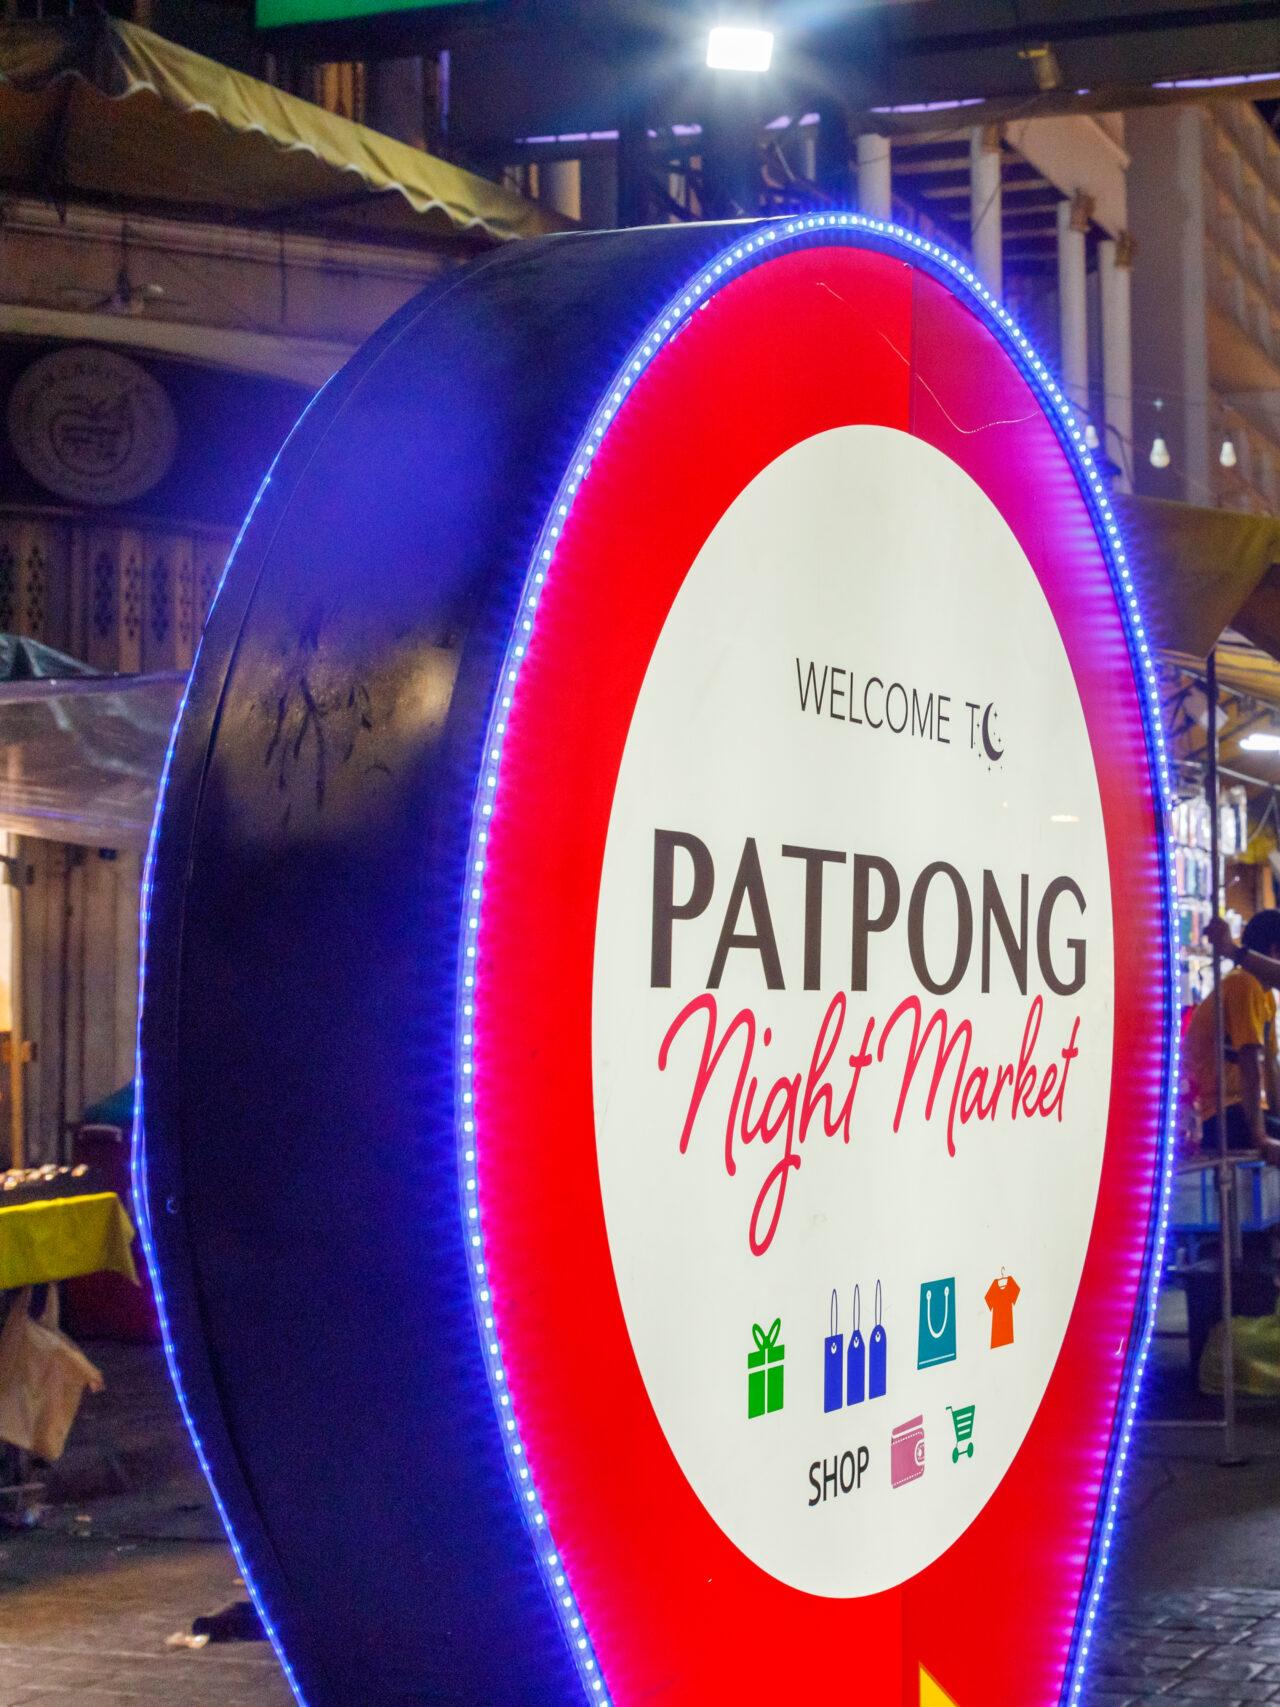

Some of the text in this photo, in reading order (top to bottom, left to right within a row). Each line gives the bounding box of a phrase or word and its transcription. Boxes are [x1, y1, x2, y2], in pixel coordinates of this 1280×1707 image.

[796, 658, 951, 744] WELCOME
[650, 829, 1087, 996] PATPONG
[658, 990, 1081, 1257] Night Market
[808, 1445, 870, 1507] SHOP
